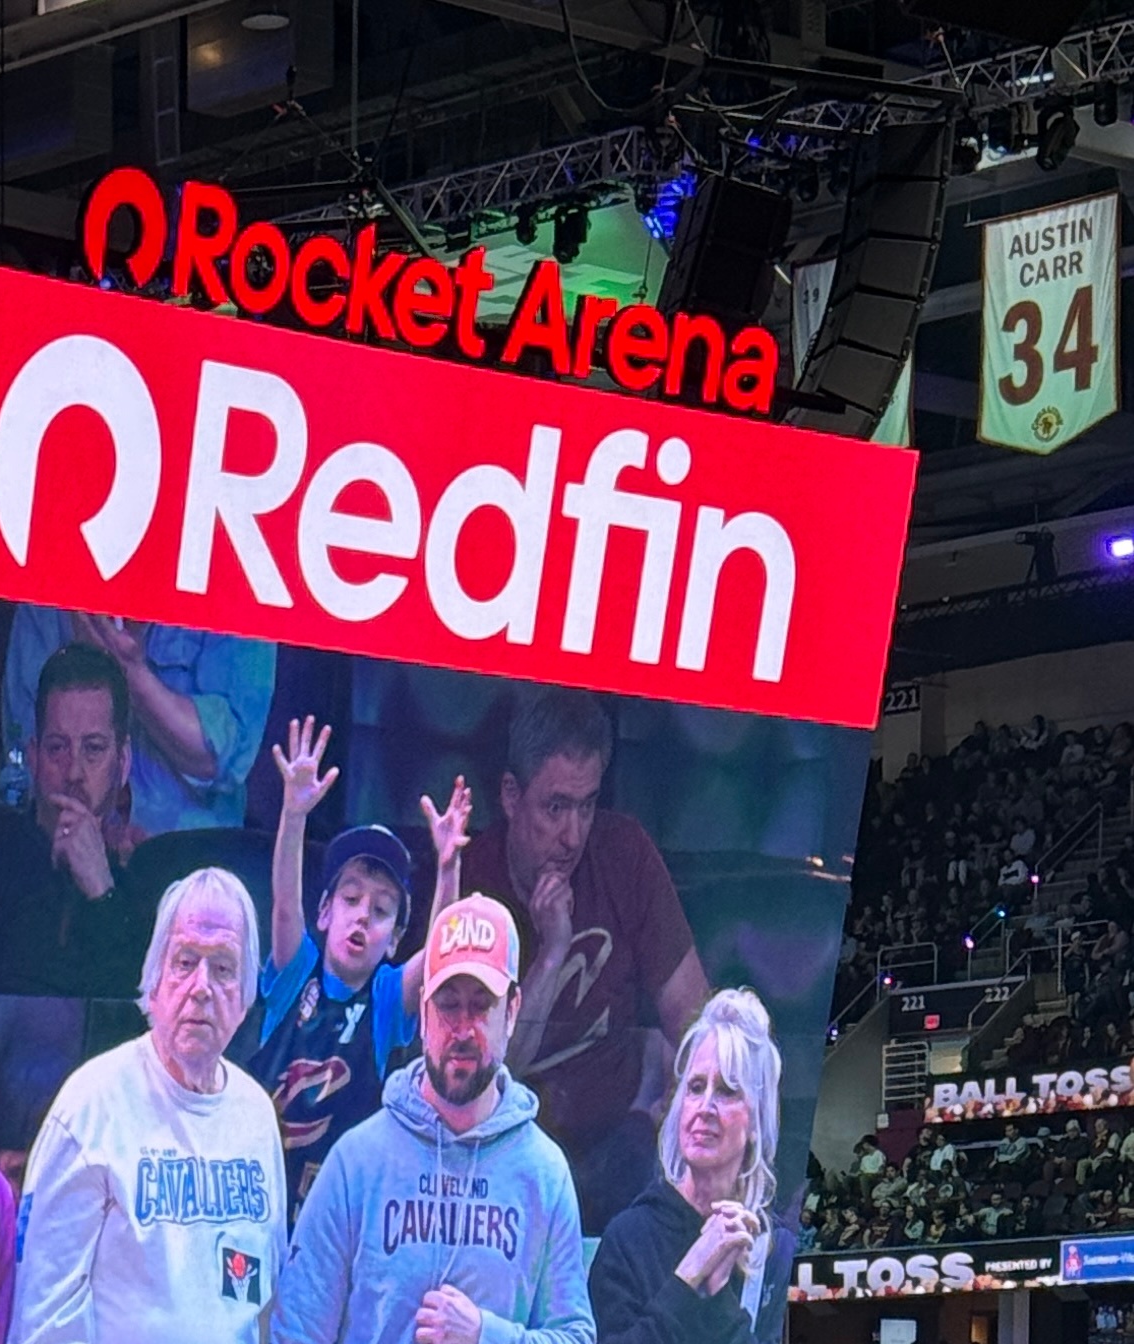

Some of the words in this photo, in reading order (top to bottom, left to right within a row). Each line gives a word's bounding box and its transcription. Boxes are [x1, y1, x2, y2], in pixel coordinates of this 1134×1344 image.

[1008, 216, 1093, 260] AUSTIN
[1019, 251, 1083, 288] CARR
[177, 181, 496, 363] Rocket
[503, 259, 780, 414] Arena
[998, 284, 1098, 406] 34
[176, 358, 796, 683] Redfin
[885, 686, 920, 710] 221
[439, 911, 496, 957] LAND
[901, 996, 926, 1012] 221
[932, 1077, 1027, 1110] BALL
[135, 1156, 271, 1227] CAVALIERS
[383, 1199, 520, 1261] CAVALIERS
[834, 1252, 975, 1296] TOSS
